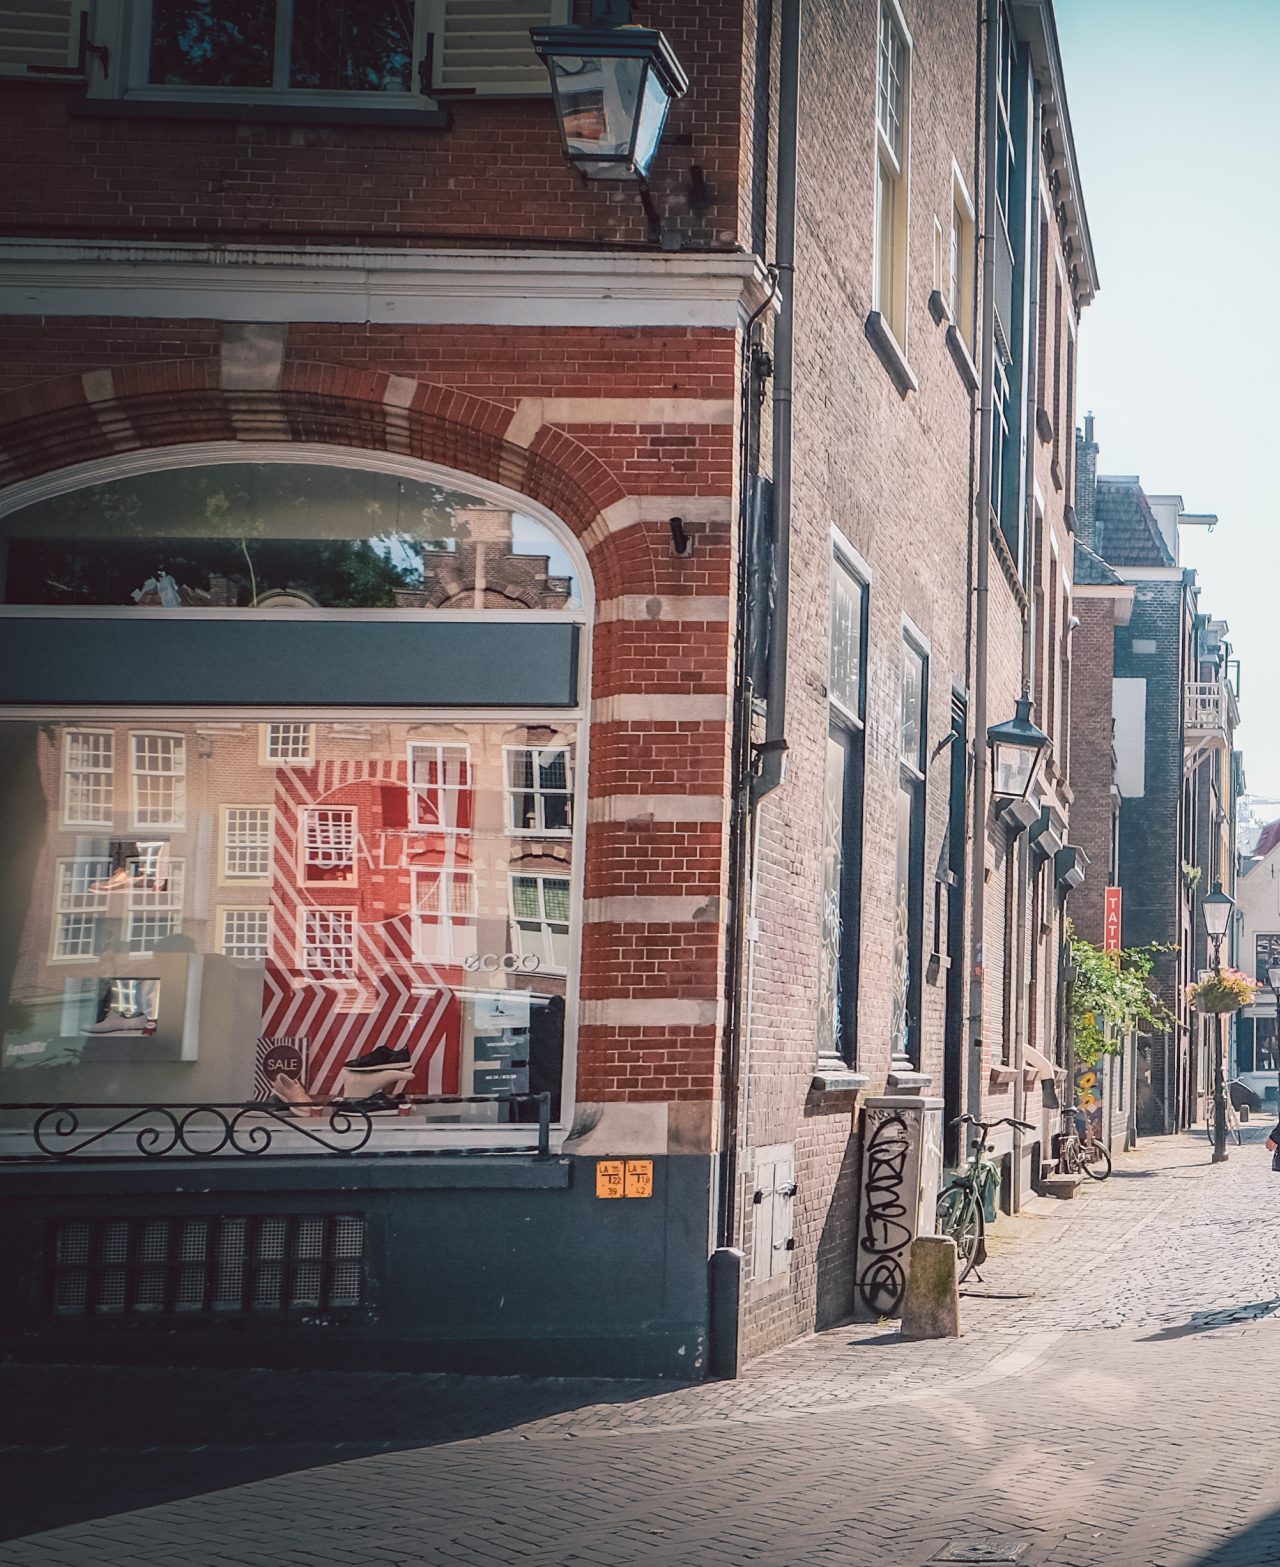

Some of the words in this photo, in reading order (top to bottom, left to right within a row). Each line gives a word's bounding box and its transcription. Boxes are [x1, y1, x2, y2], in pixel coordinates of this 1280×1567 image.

[267, 1059, 298, 1070] SALE
[598, 1165, 608, 1173] LA
[627, 1164, 637, 1173] LA
[607, 1187, 618, 1196] 39
